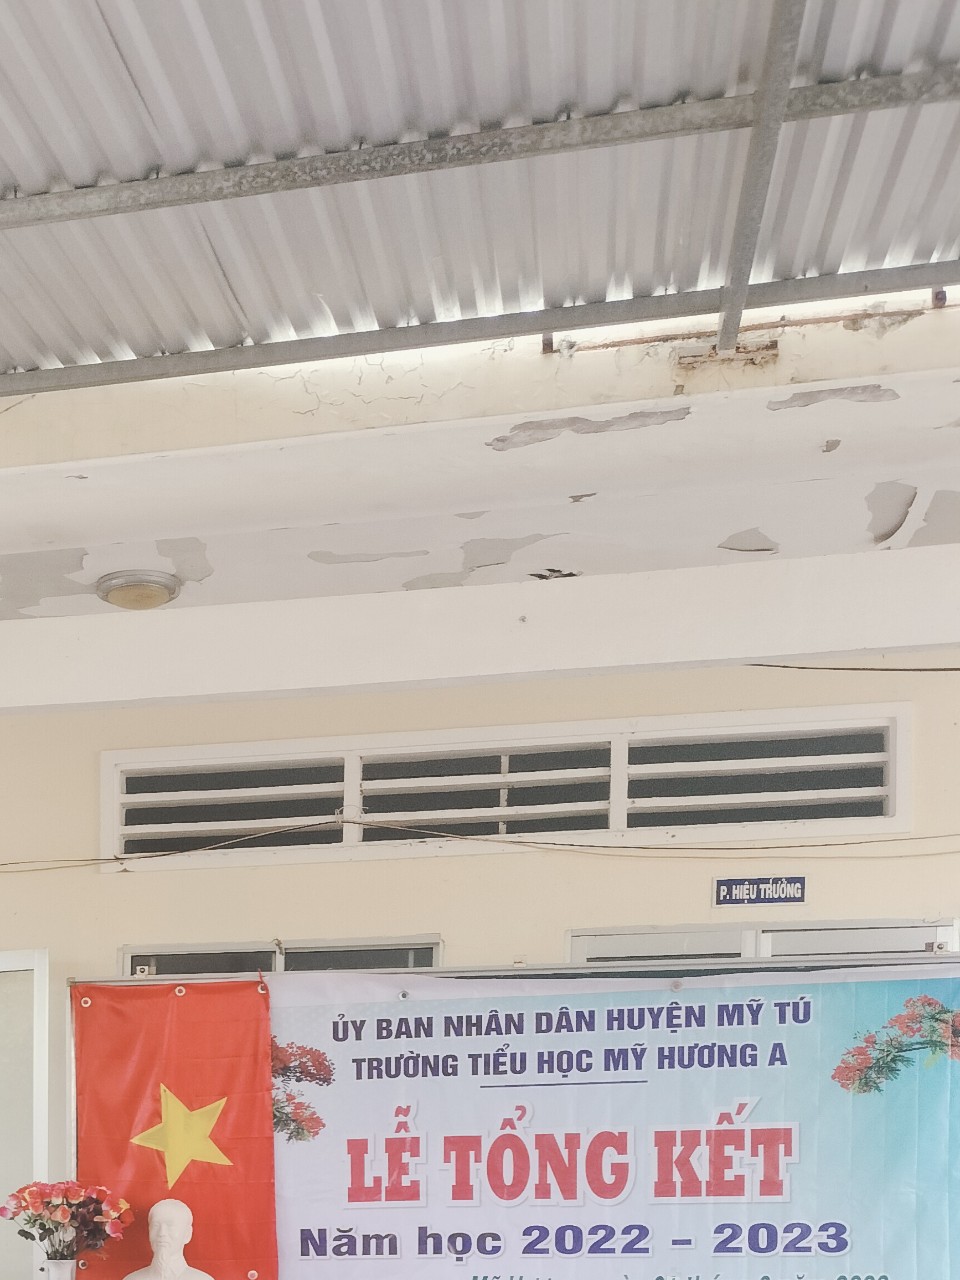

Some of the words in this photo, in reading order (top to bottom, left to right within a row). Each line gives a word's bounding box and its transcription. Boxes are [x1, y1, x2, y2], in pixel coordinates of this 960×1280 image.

[720, 885, 730, 901] P.
[732, 881, 758, 904] HIỆU
[759, 878, 802, 899] TRƯỞNG
[332, 1013, 367, 1042] ỦY
[376, 1016, 433, 1040] BAN
[444, 1009, 524, 1037] NHÂN
[535, 1006, 596, 1034] DÂN
[606, 1001, 706, 1034] HUYỆN
[717, 998, 764, 1027] MỸ
[774, 996, 811, 1025] TÚ
[352, 1050, 458, 1080] TRƯỜNG
[468, 1043, 527, 1076] TIỂU
[537, 1050, 593, 1079] HỌC
[603, 1042, 648, 1072] MỸ
[657, 1042, 758, 1070] HƯƠNG
[768, 1042, 788, 1067] A
[346, 1105, 421, 1202] LỄ
[443, 1105, 630, 1201] TỔNG
[653, 1102, 793, 1198] KẾT
[300, 1227, 398, 1257] Năm
[417, 1226, 502, 1262] học
[521, 1224, 650, 1255] 2022
[713, 1222, 849, 1254] 2023
